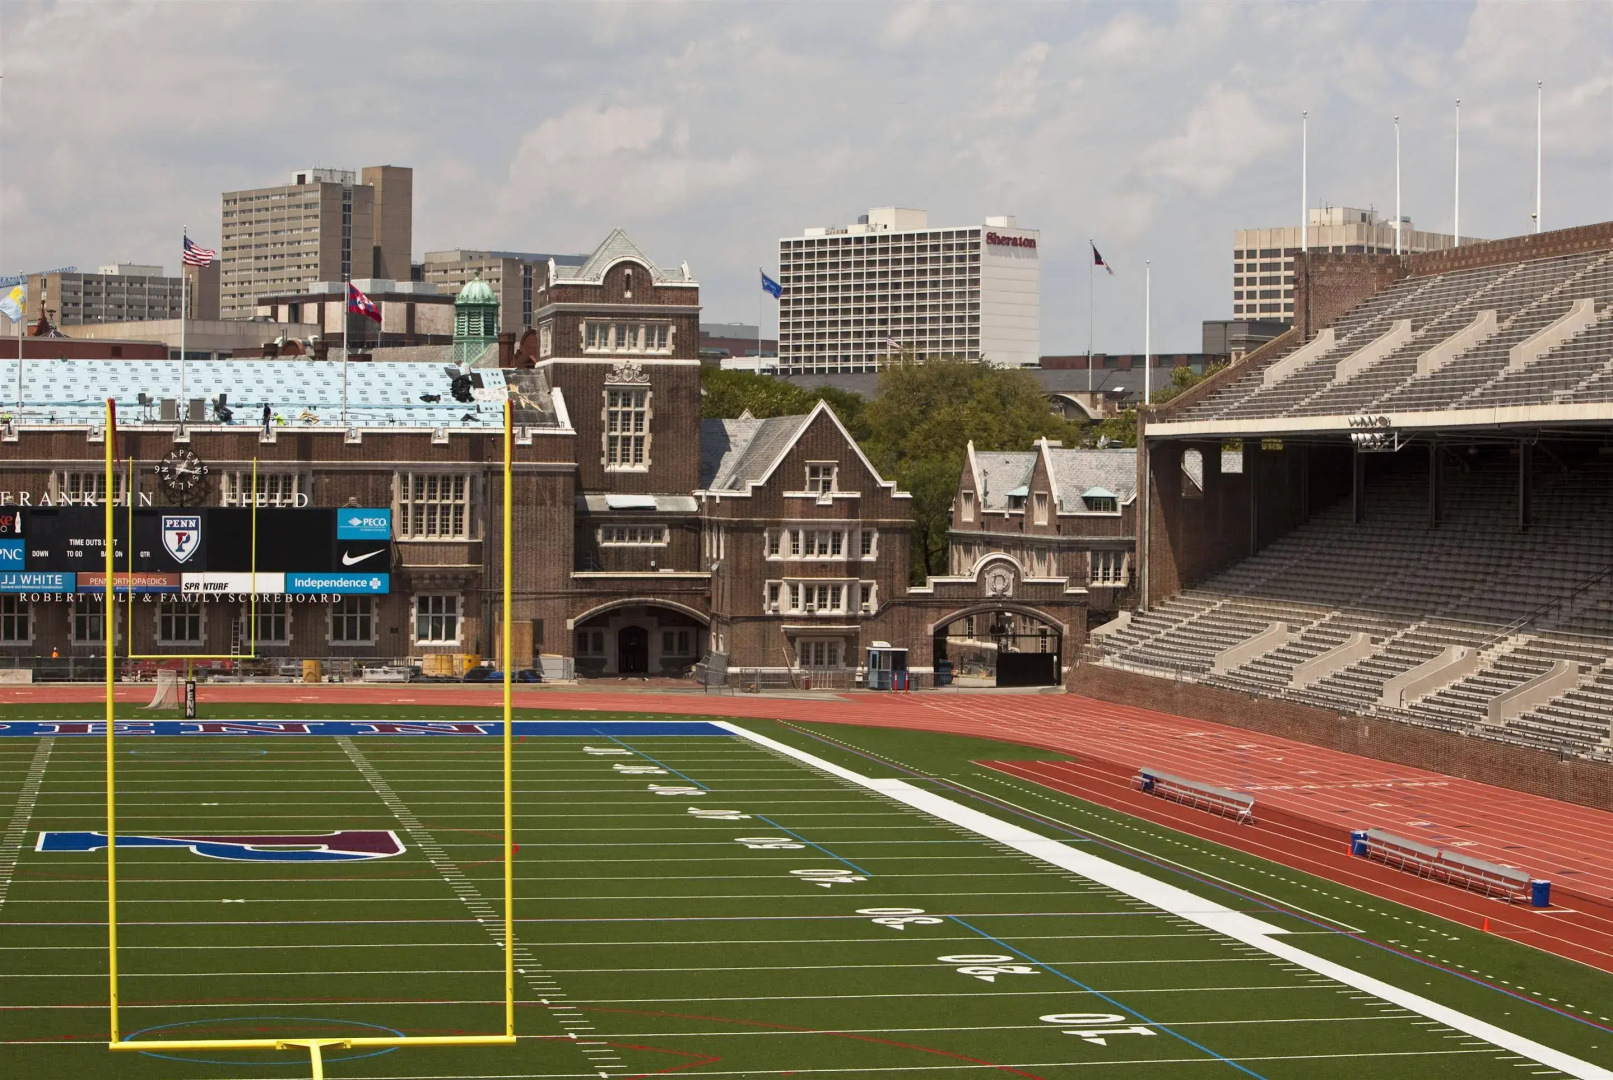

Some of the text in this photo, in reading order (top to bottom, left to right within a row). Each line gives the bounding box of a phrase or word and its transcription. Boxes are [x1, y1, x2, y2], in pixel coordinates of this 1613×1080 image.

[985, 231, 1036, 248] Sheraton
[222, 491, 309, 508] FIELD
[165, 519, 197, 528] PENN
[362, 517, 387, 527] PECO
[69, 538, 118, 546] TIME OUTS LT
[175, 531, 191, 553] P
[31, 550, 49, 558] DOWN
[66, 550, 83, 558] TO GO
[114, 550, 123, 558] ON
[139, 550, 151, 558] QTR
[20, 574, 63, 585] WHITE
[294, 577, 368, 590] Independence
[183, 582, 229, 591] SPRNTURF
[19, 592, 85, 602] ROBERT
[142, 592, 153, 603] &
[160, 592, 222, 603] FAMILY
[228, 593, 342, 603] SCOREBOARD
[186, 683, 195, 717] PENN
[0, 722, 495, 735] ENN
[789, 868, 868, 884] 40
[855, 907, 944, 926] 30
[936, 954, 1042, 975] 20
[1038, 1013, 1159, 1038] 10
